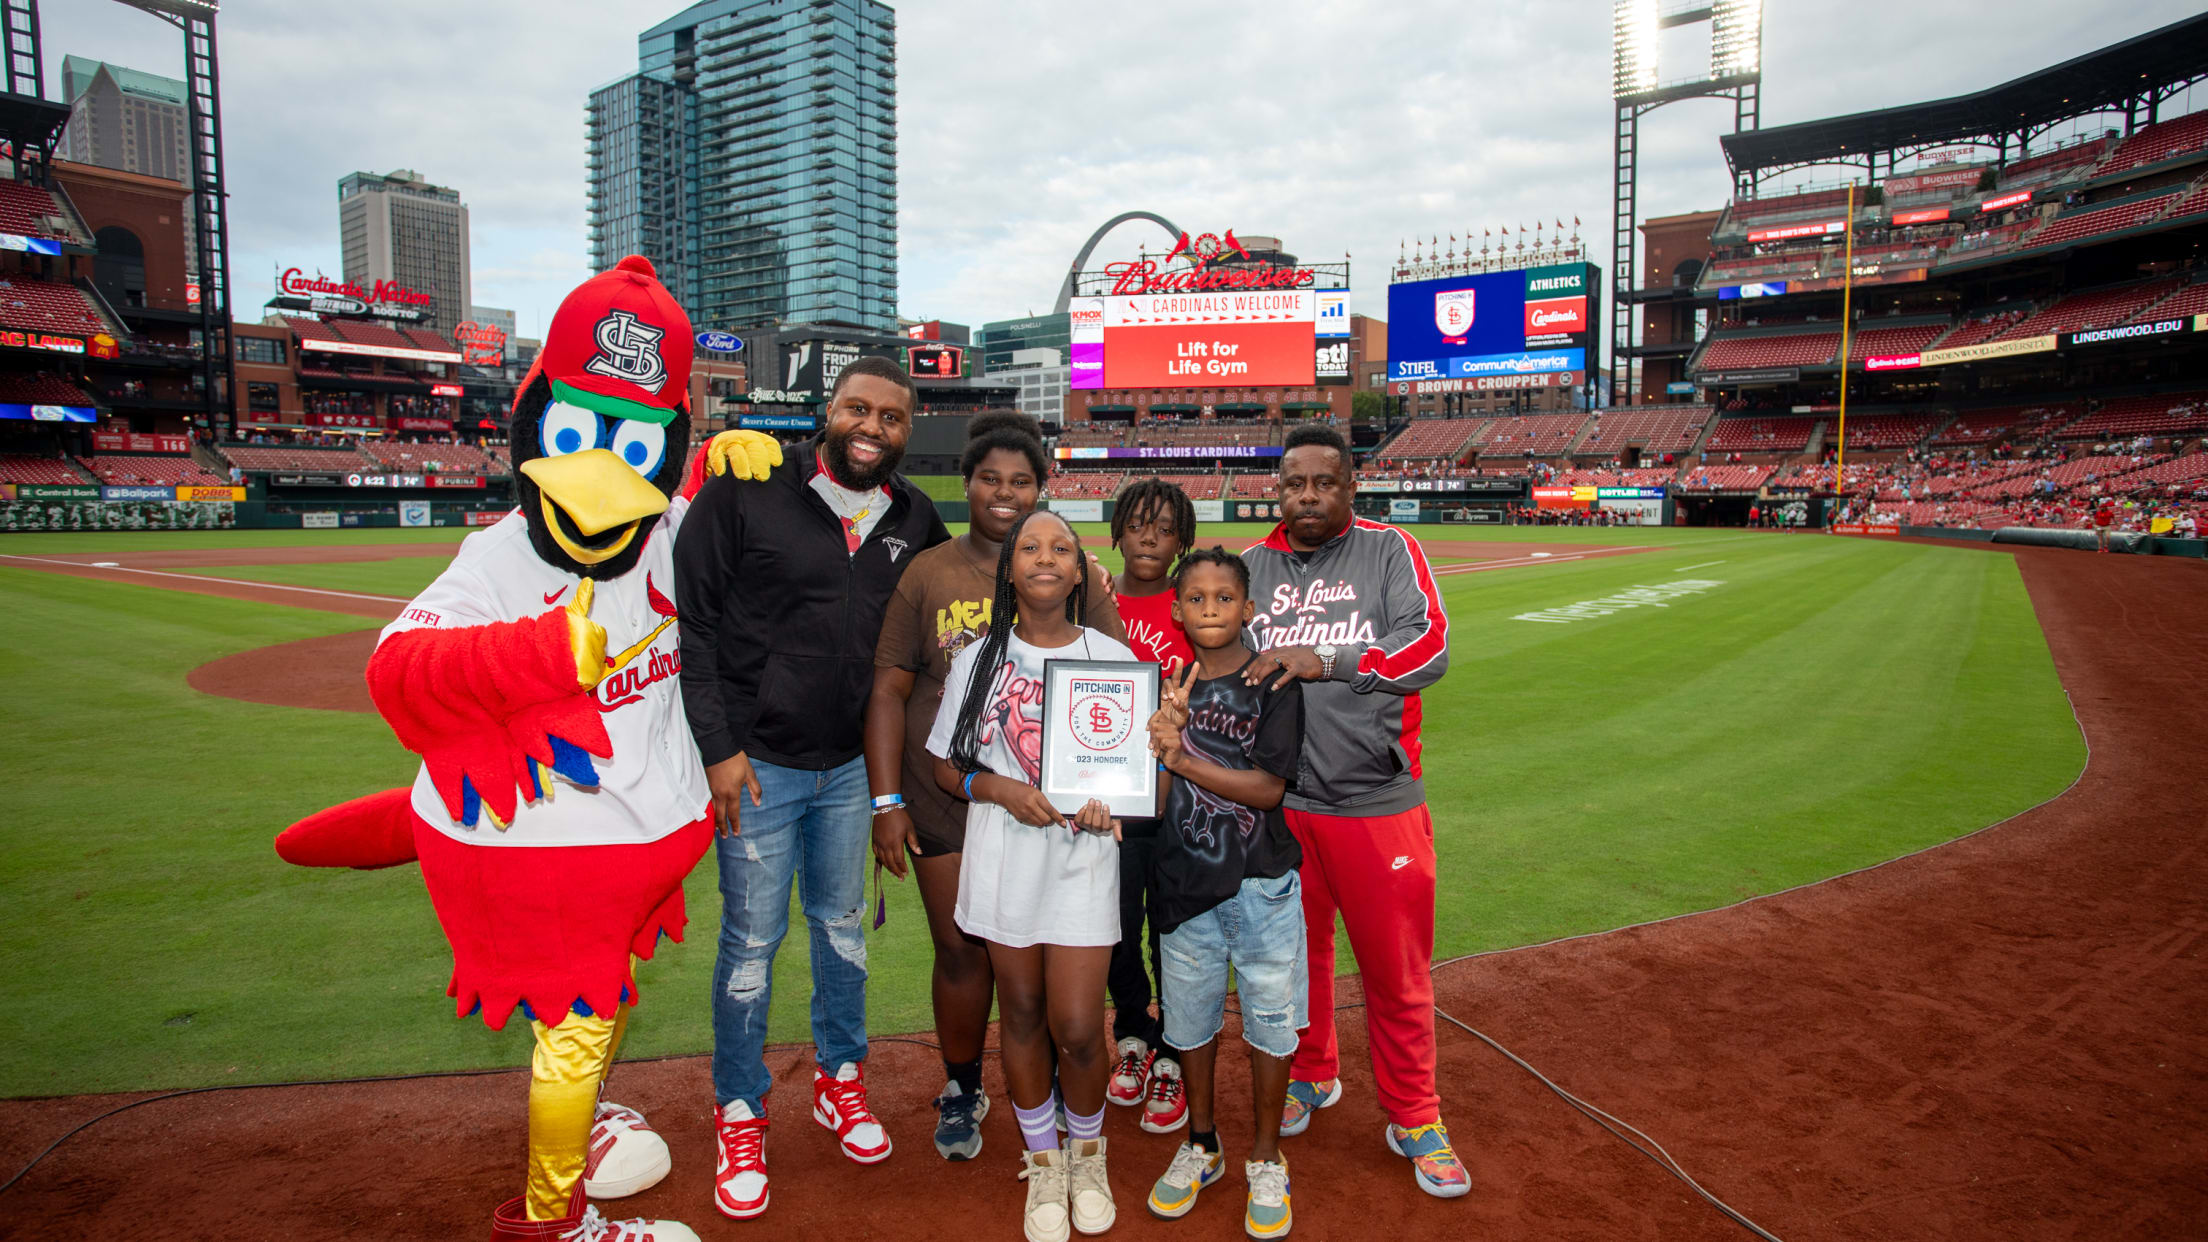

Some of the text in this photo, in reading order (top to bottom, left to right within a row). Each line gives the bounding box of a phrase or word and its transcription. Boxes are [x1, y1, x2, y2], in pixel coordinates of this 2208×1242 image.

[1922, 170, 1981, 185] BUDWEISER
[1105, 259, 1315, 296] Budweiser
[1529, 275, 1581, 292] ATHLETICS
[281, 267, 431, 306] Cardinals Nation
[1153, 295, 1302, 313] CARDINALS WELCOME
[373, 307, 419, 319] ROOFTOP
[1071, 310, 1103, 319] KMOX
[1531, 309, 1578, 327] Cardinals
[2072, 319, 2183, 345] LINDENWOOD.EDU
[27, 333, 85, 354] LAND
[706, 333, 735, 350] Ford
[834, 344, 860, 353] PHORM
[1177, 341, 1239, 357] Lift for
[1316, 342, 1349, 364] stl
[1168, 359, 1248, 377] Life Gym
[1315, 362, 1348, 371] TODAY
[1398, 360, 1438, 376] STIFEL
[1867, 358, 1895, 368] Cardinals
[1416, 374, 1549, 393] BROWN & CROUPPEN
[764, 418, 790, 426] CREDIT
[162, 440, 186, 451] 166
[1140, 446, 1256, 458] ST. LOUIS CARDINALS
[364, 476, 386, 486] 6:22
[444, 478, 475, 486] PURINA
[1415, 481, 1432, 490] 6:22
[35, 488, 100, 498] Central Bank
[121, 488, 169, 499] Ballpark
[191, 488, 233, 497] DOBBS
[1270, 578, 1358, 616] St. Louis
[1247, 610, 1377, 653] Cardinals
[1121, 618, 1179, 671] INALS
[1074, 682, 1131, 694] PITCHING IN
[1080, 732, 1093, 744] THE
[1095, 717, 1128, 747] COMMUNITY
